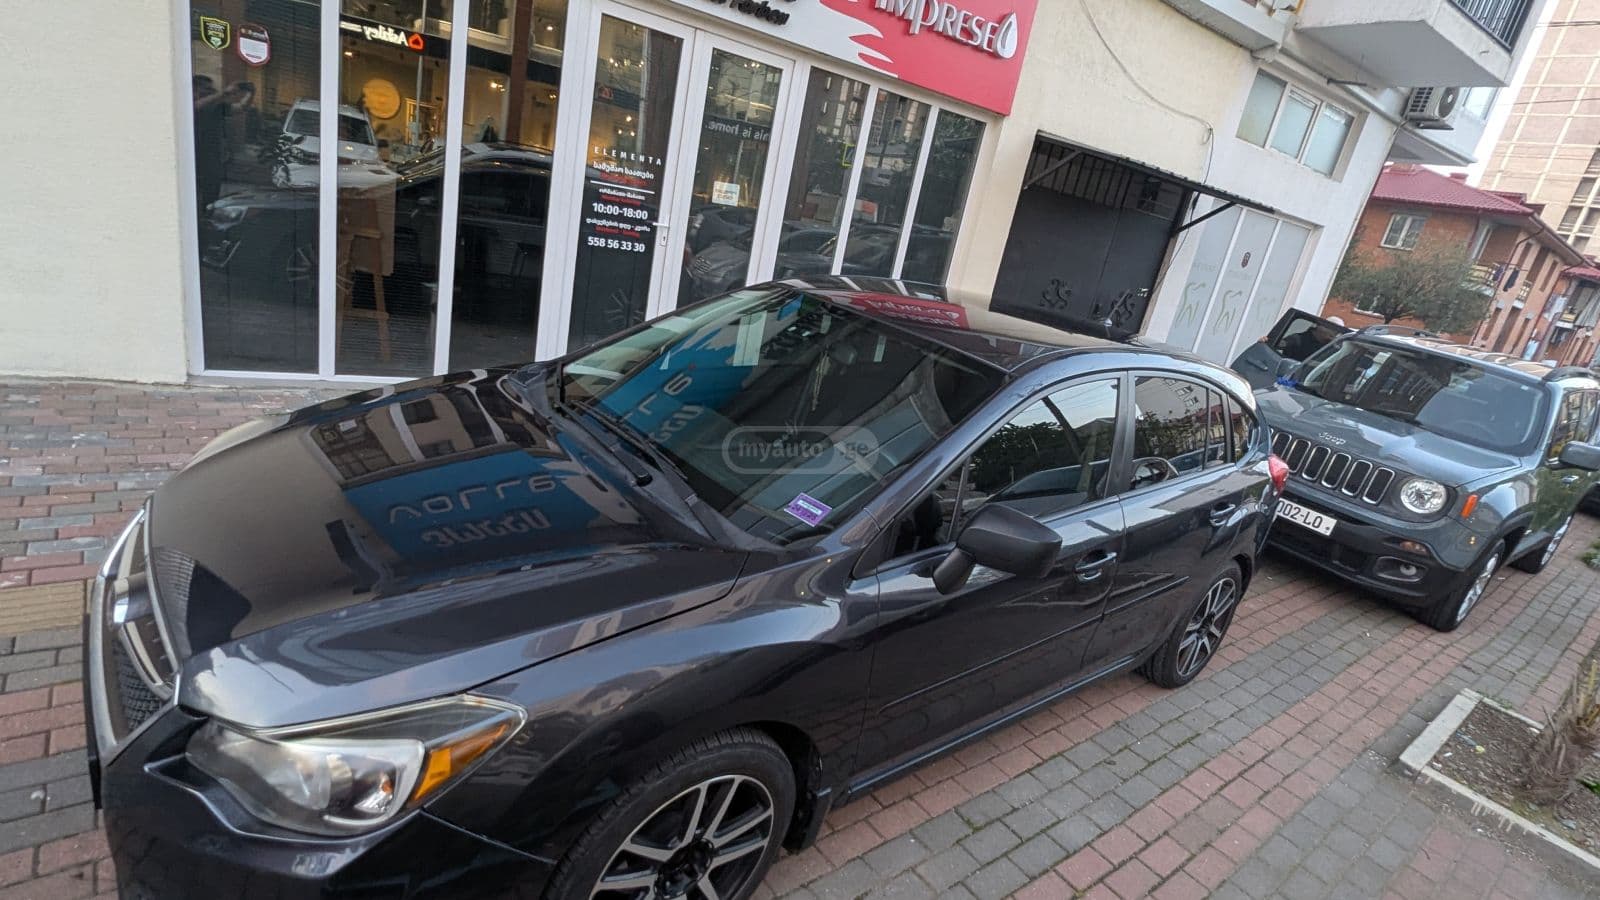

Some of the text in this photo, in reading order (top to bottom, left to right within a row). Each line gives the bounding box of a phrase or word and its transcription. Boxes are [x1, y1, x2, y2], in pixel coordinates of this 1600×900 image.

[594, 146, 662, 166] ELEMENTA
[592, 202, 649, 220] 10:00-18:00
[587, 236, 646, 253] 558 56 33 30
[1318, 431, 1346, 445] Jeep
